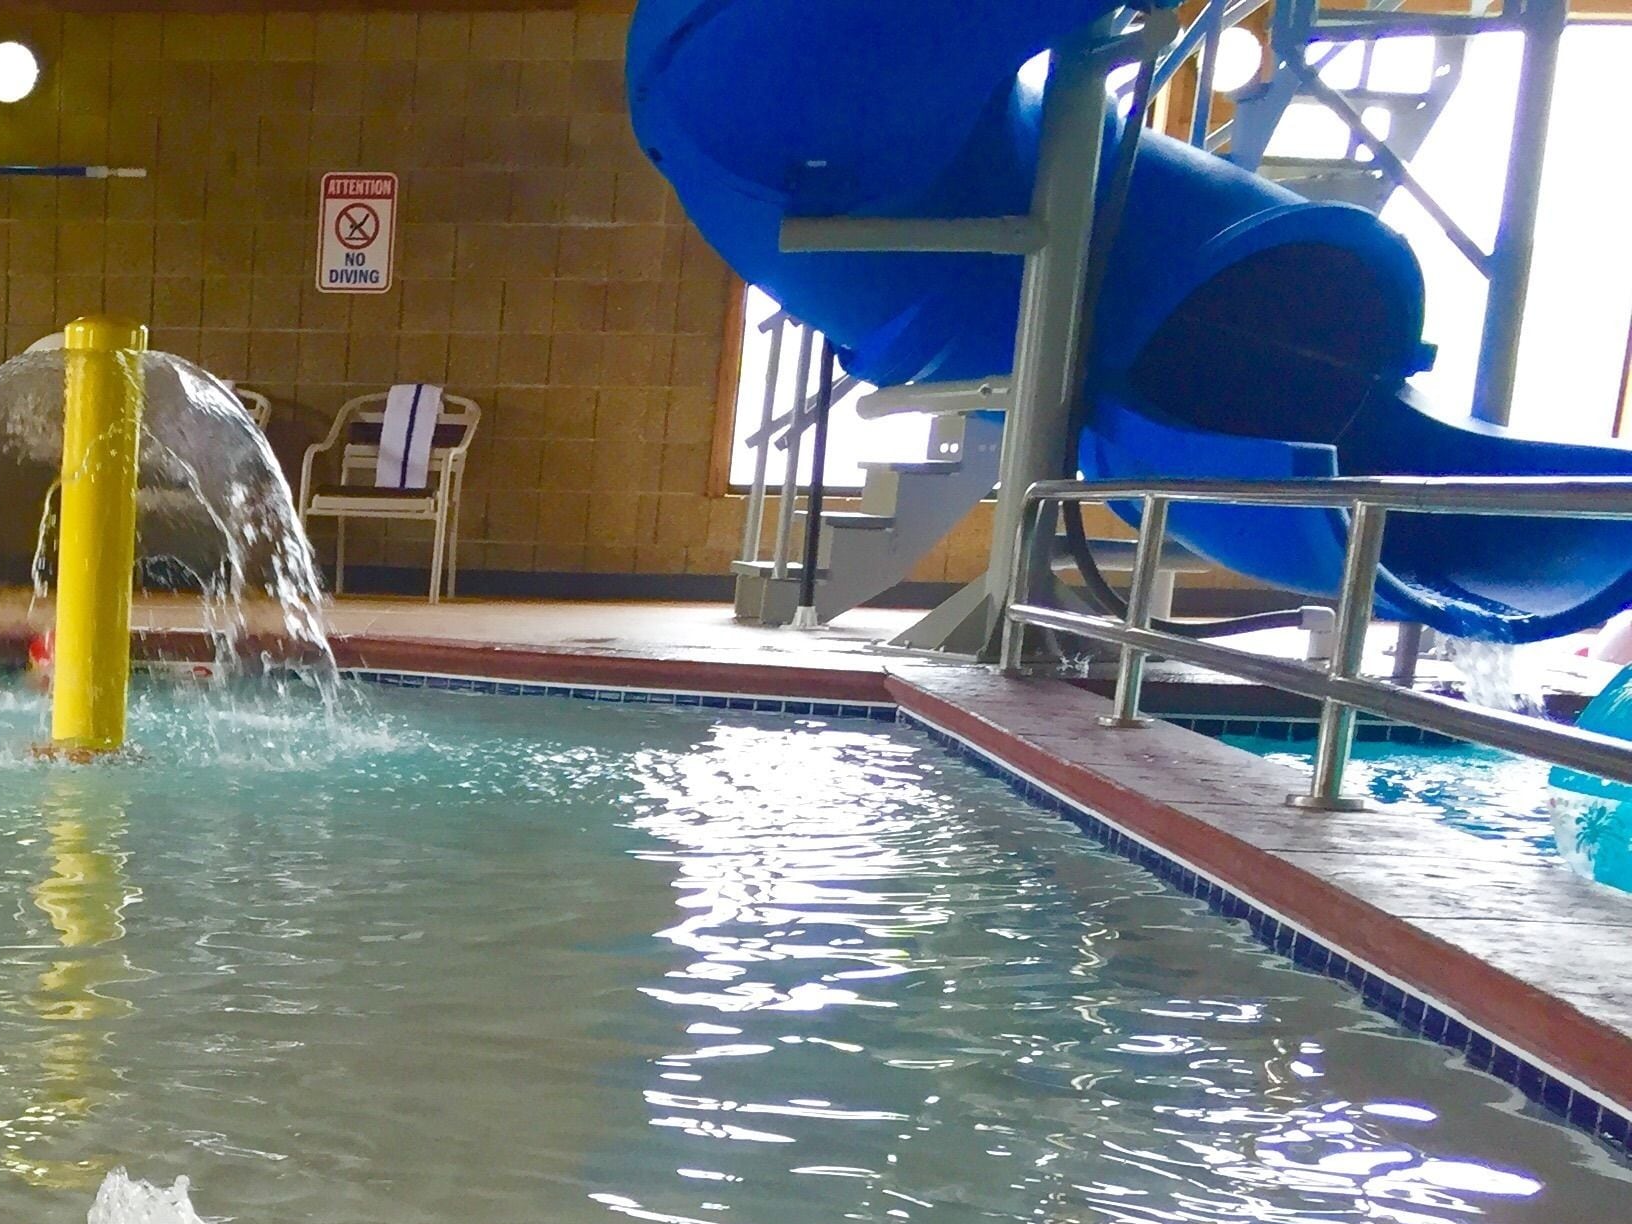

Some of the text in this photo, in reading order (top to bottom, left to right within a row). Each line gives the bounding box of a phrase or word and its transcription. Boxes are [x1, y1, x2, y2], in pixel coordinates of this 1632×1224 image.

[327, 179, 393, 195] ATTENTION
[345, 252, 366, 267] NO
[329, 269, 380, 284] DIVING
